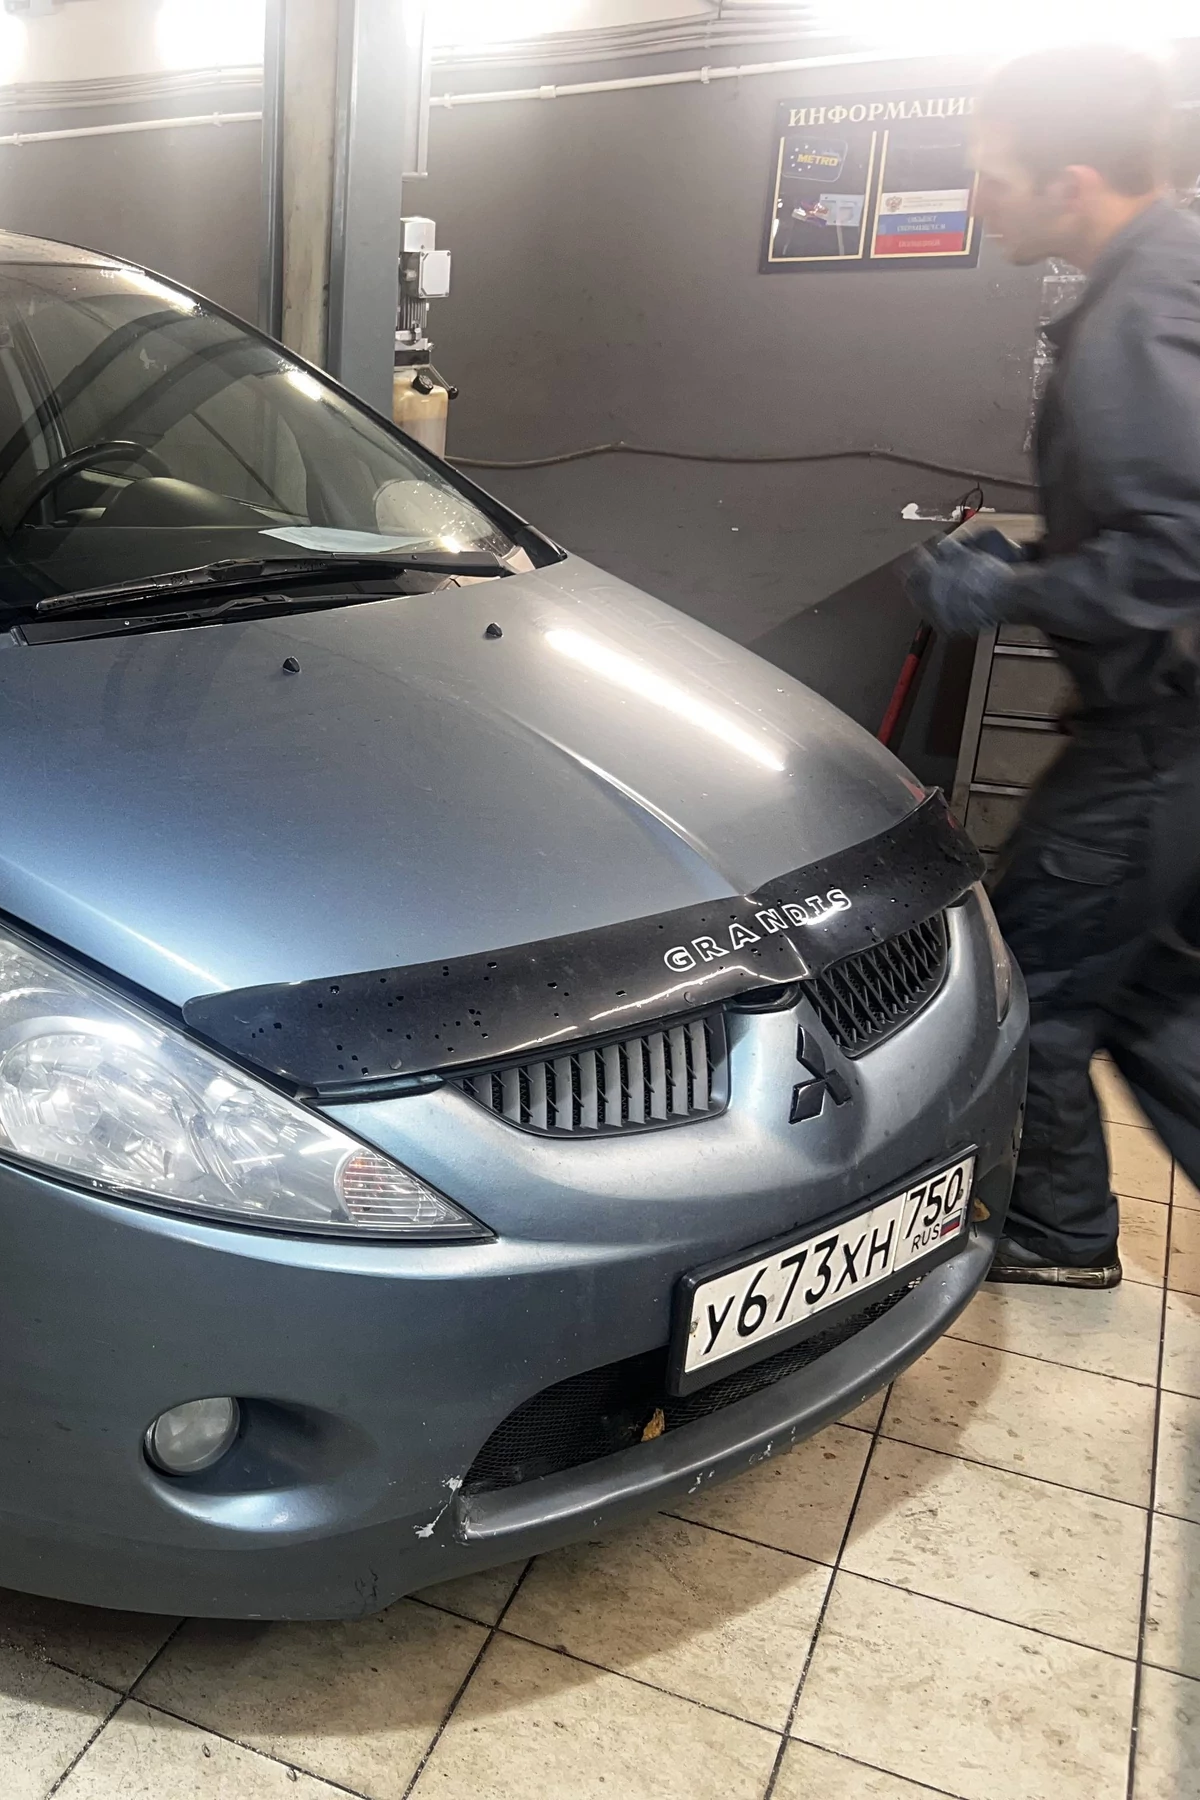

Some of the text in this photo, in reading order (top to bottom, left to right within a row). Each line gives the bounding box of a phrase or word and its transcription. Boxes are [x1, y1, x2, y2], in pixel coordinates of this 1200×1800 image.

[797, 153, 839, 167] METRO
[664, 889, 852, 972] GRANDIS
[911, 1223, 940, 1253] RUS
